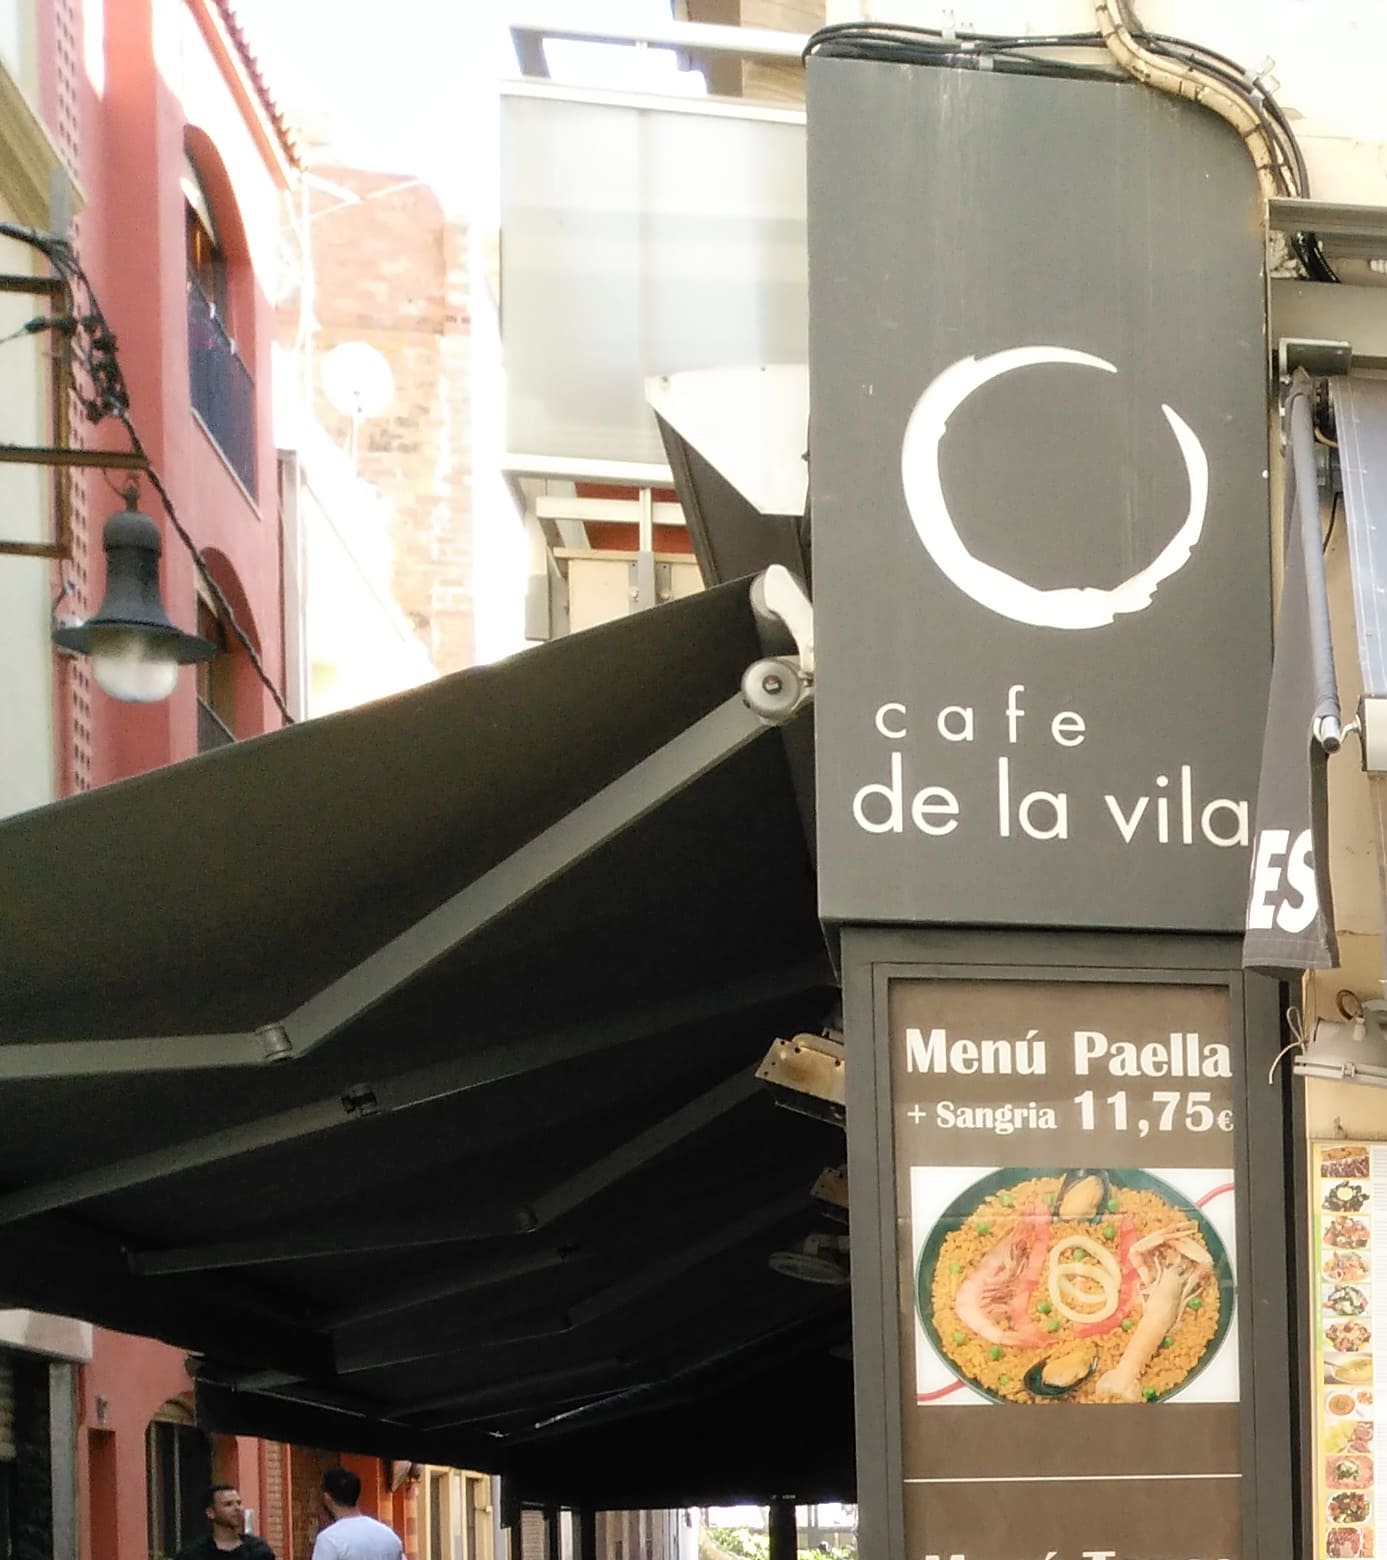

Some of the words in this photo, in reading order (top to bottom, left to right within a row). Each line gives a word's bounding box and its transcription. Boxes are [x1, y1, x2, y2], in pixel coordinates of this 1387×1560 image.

[876, 685, 1086, 746] cafe
[853, 752, 960, 836] de
[999, 756, 1068, 840] la
[1104, 765, 1250, 848] vila
[905, 1028, 1048, 1076] Menú
[1073, 1031, 1233, 1078] Paella
[936, 1101, 1058, 1135] Sangria
